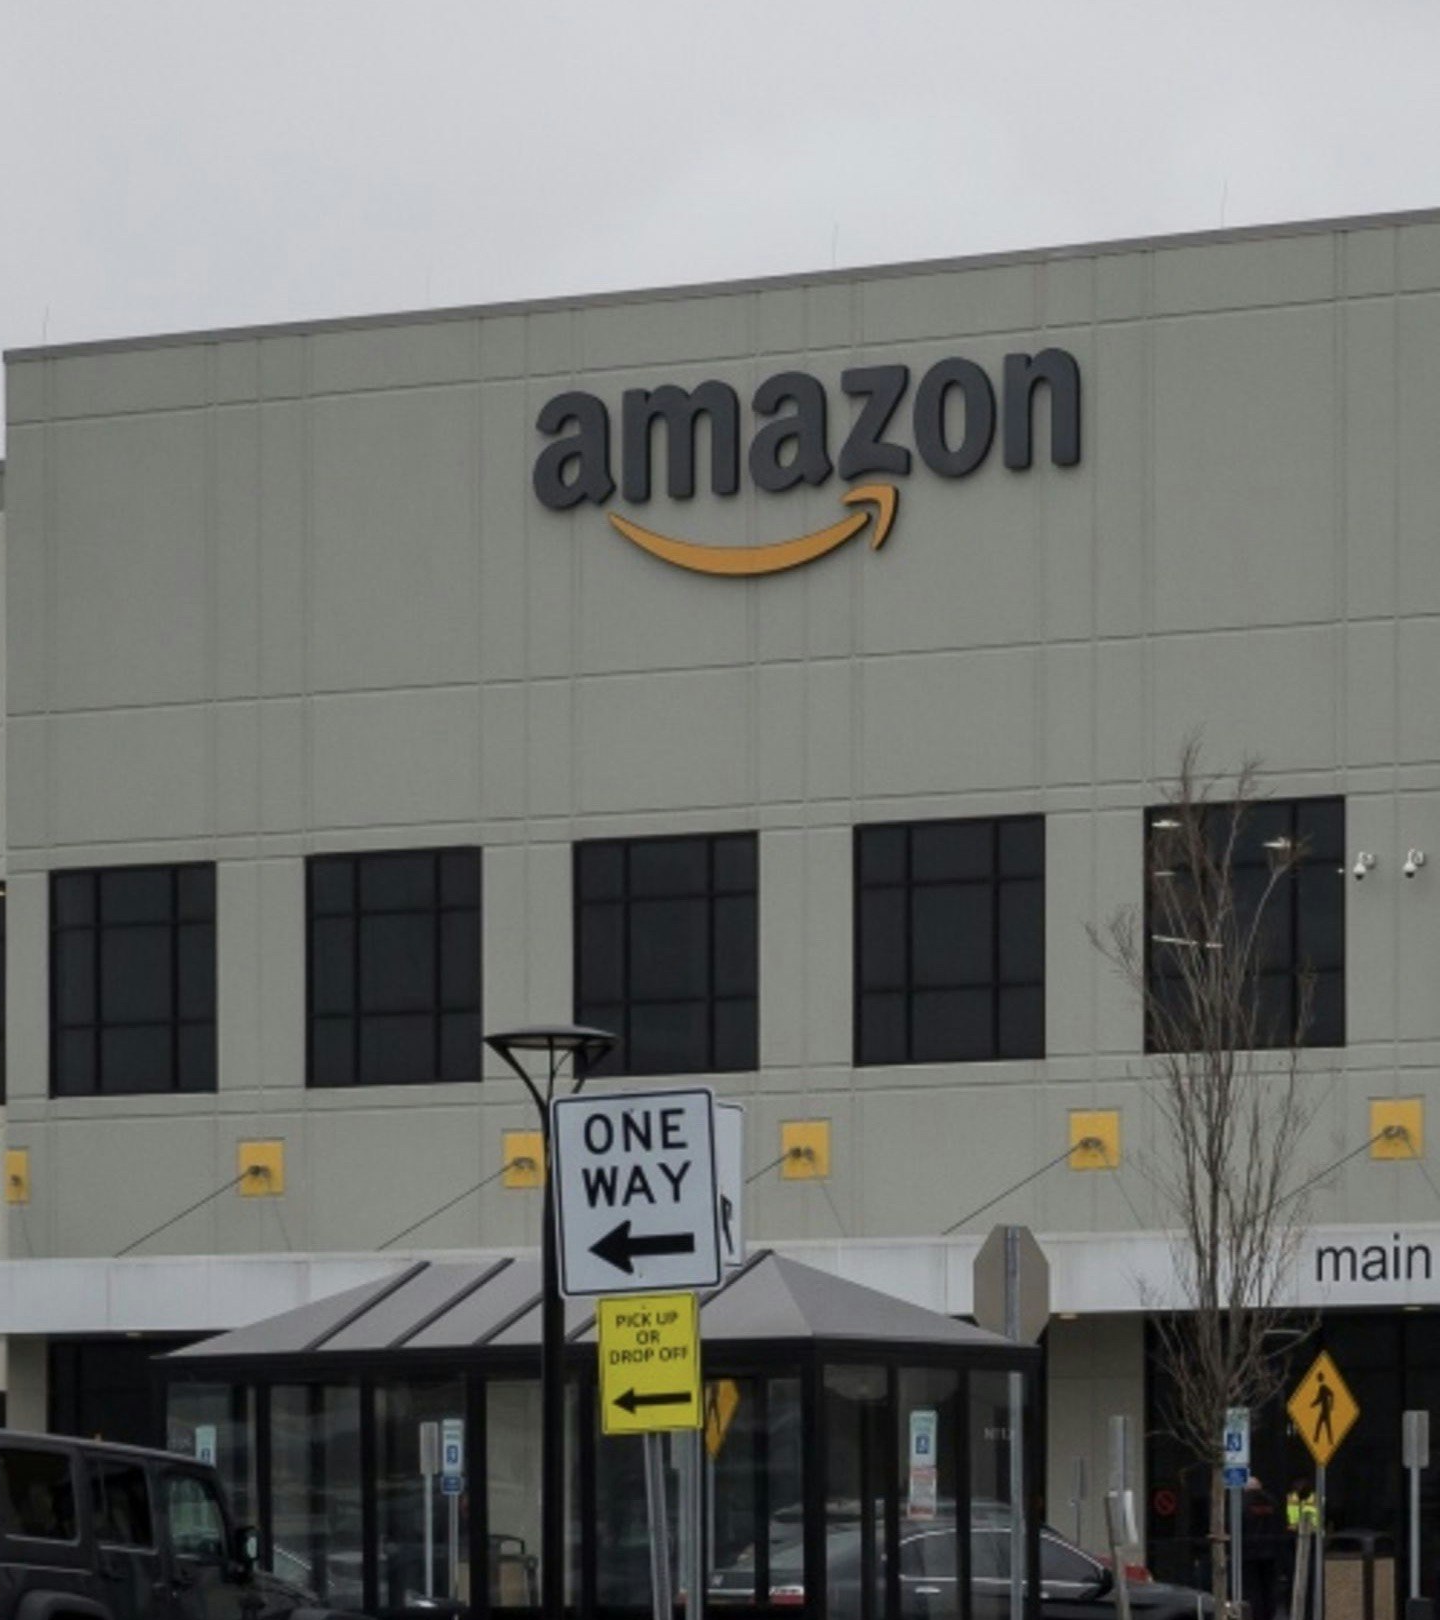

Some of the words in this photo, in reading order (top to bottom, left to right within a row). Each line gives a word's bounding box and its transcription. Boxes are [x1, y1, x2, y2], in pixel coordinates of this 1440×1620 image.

[533, 348, 1082, 511] amazon
[584, 1108, 688, 1155] ONE
[582, 1161, 691, 1208] WAY
[1316, 1232, 1431, 1282] main
[616, 1312, 652, 1328] PICK
[656, 1310, 678, 1325] UP
[636, 1330, 660, 1345] OR
[610, 1347, 654, 1365] DROP
[659, 1346, 687, 1361] OFF
